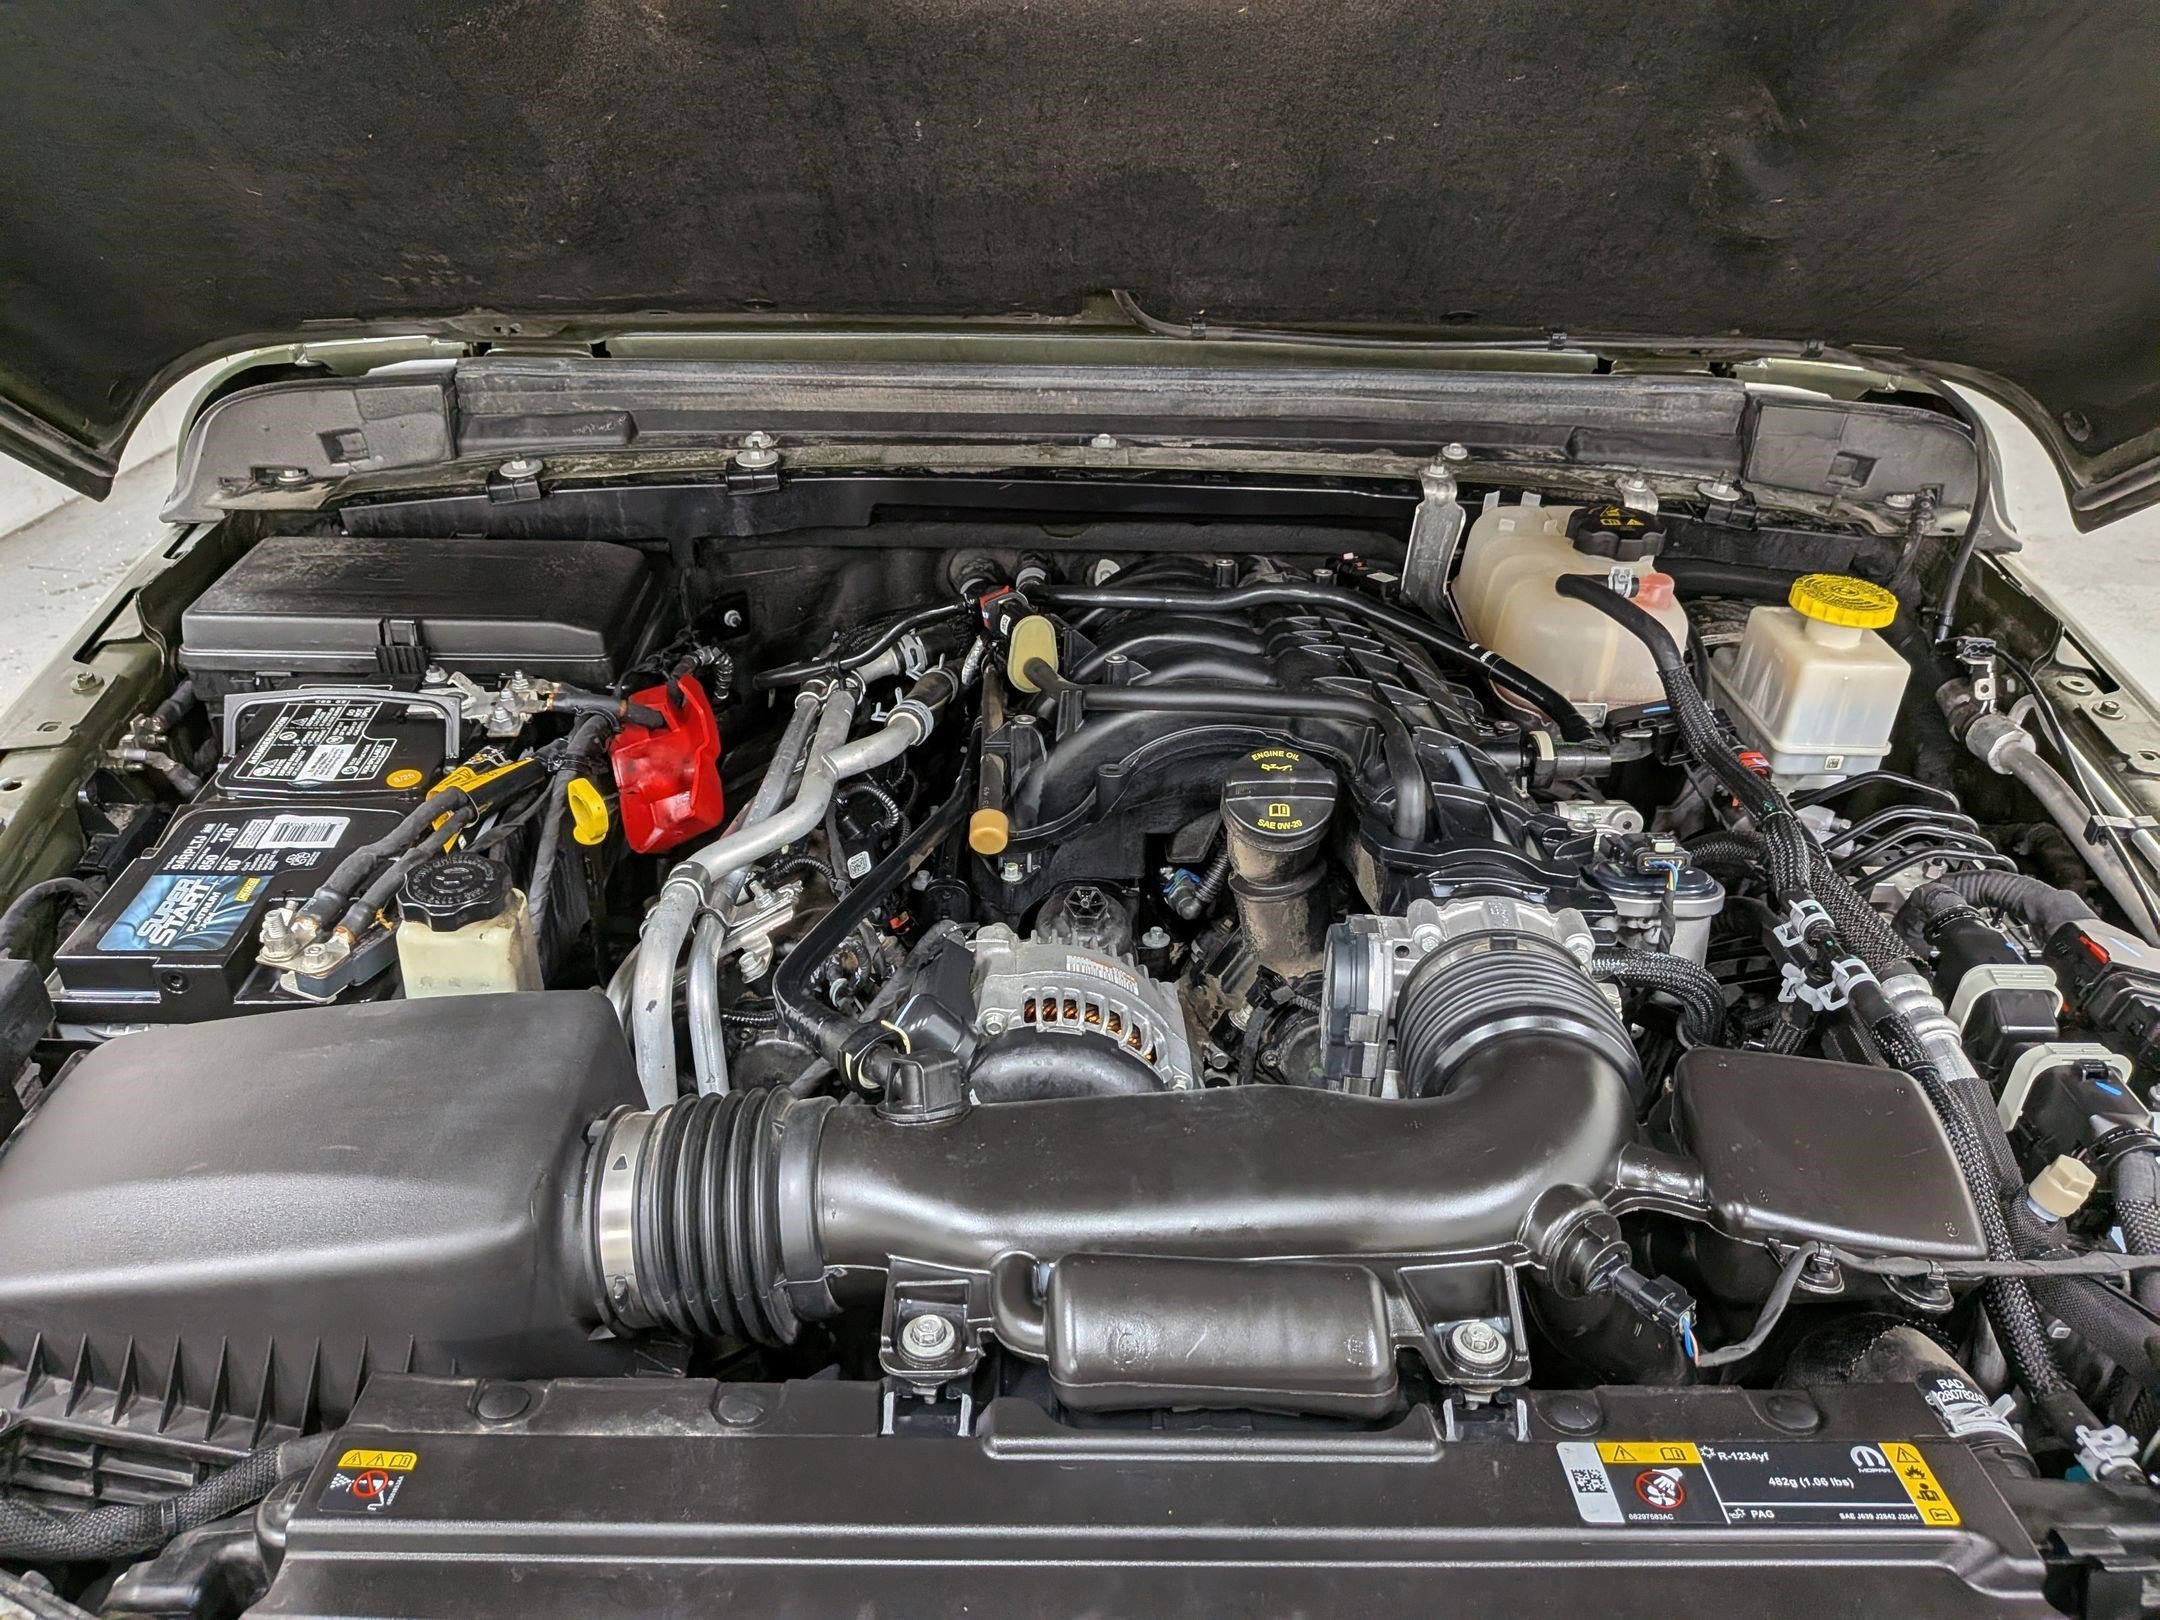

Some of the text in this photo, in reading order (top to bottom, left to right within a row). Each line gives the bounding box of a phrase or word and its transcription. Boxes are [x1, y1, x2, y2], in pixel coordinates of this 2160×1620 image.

[1251, 750, 1300, 761] ENGINE OIL
[1257, 818, 1303, 830] SAE 0W-20
[219, 827, 239, 843] 140
[171, 835, 207, 870] 94RPLTJ
[199, 854, 219, 871] 850
[225, 859, 242, 871] 80
[137, 879, 195, 937] SUPER
[148, 879, 210, 947] START
[185, 891, 222, 932] PLATINUM
[1936, 1379, 1965, 1389] RAD
[1925, 1389, 1989, 1406] 6280782AD
[1717, 1452, 1769, 1463] R-1234yf
[1768, 1477, 1854, 1489] 482g (1.06 lbs)
[1751, 1510, 1775, 1519] PAG
[1839, 1512, 1856, 1520] SAE
